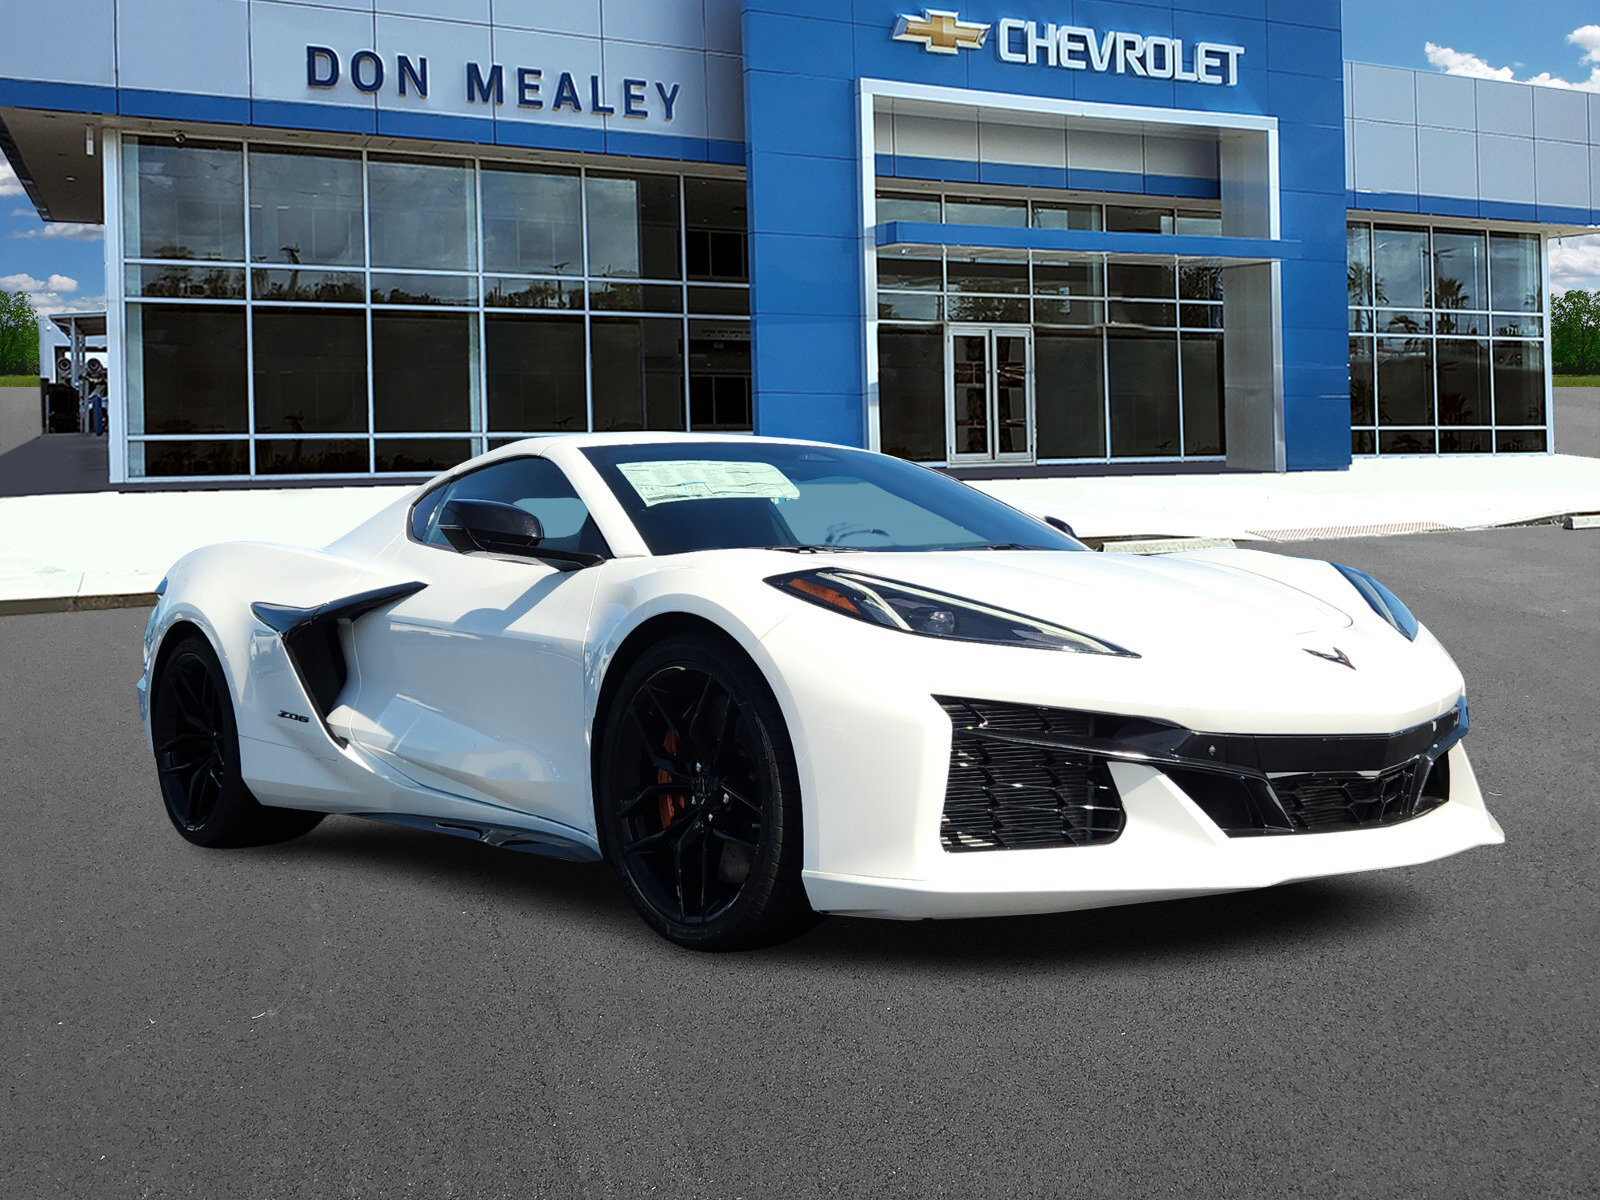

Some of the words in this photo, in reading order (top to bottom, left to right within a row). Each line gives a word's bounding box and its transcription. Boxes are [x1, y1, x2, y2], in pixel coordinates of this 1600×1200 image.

[306, 45, 429, 99] DON
[466, 62, 680, 122] MEALEY
[997, 17, 1246, 86] CHEVROLET
[277, 709, 309, 723] Z06
